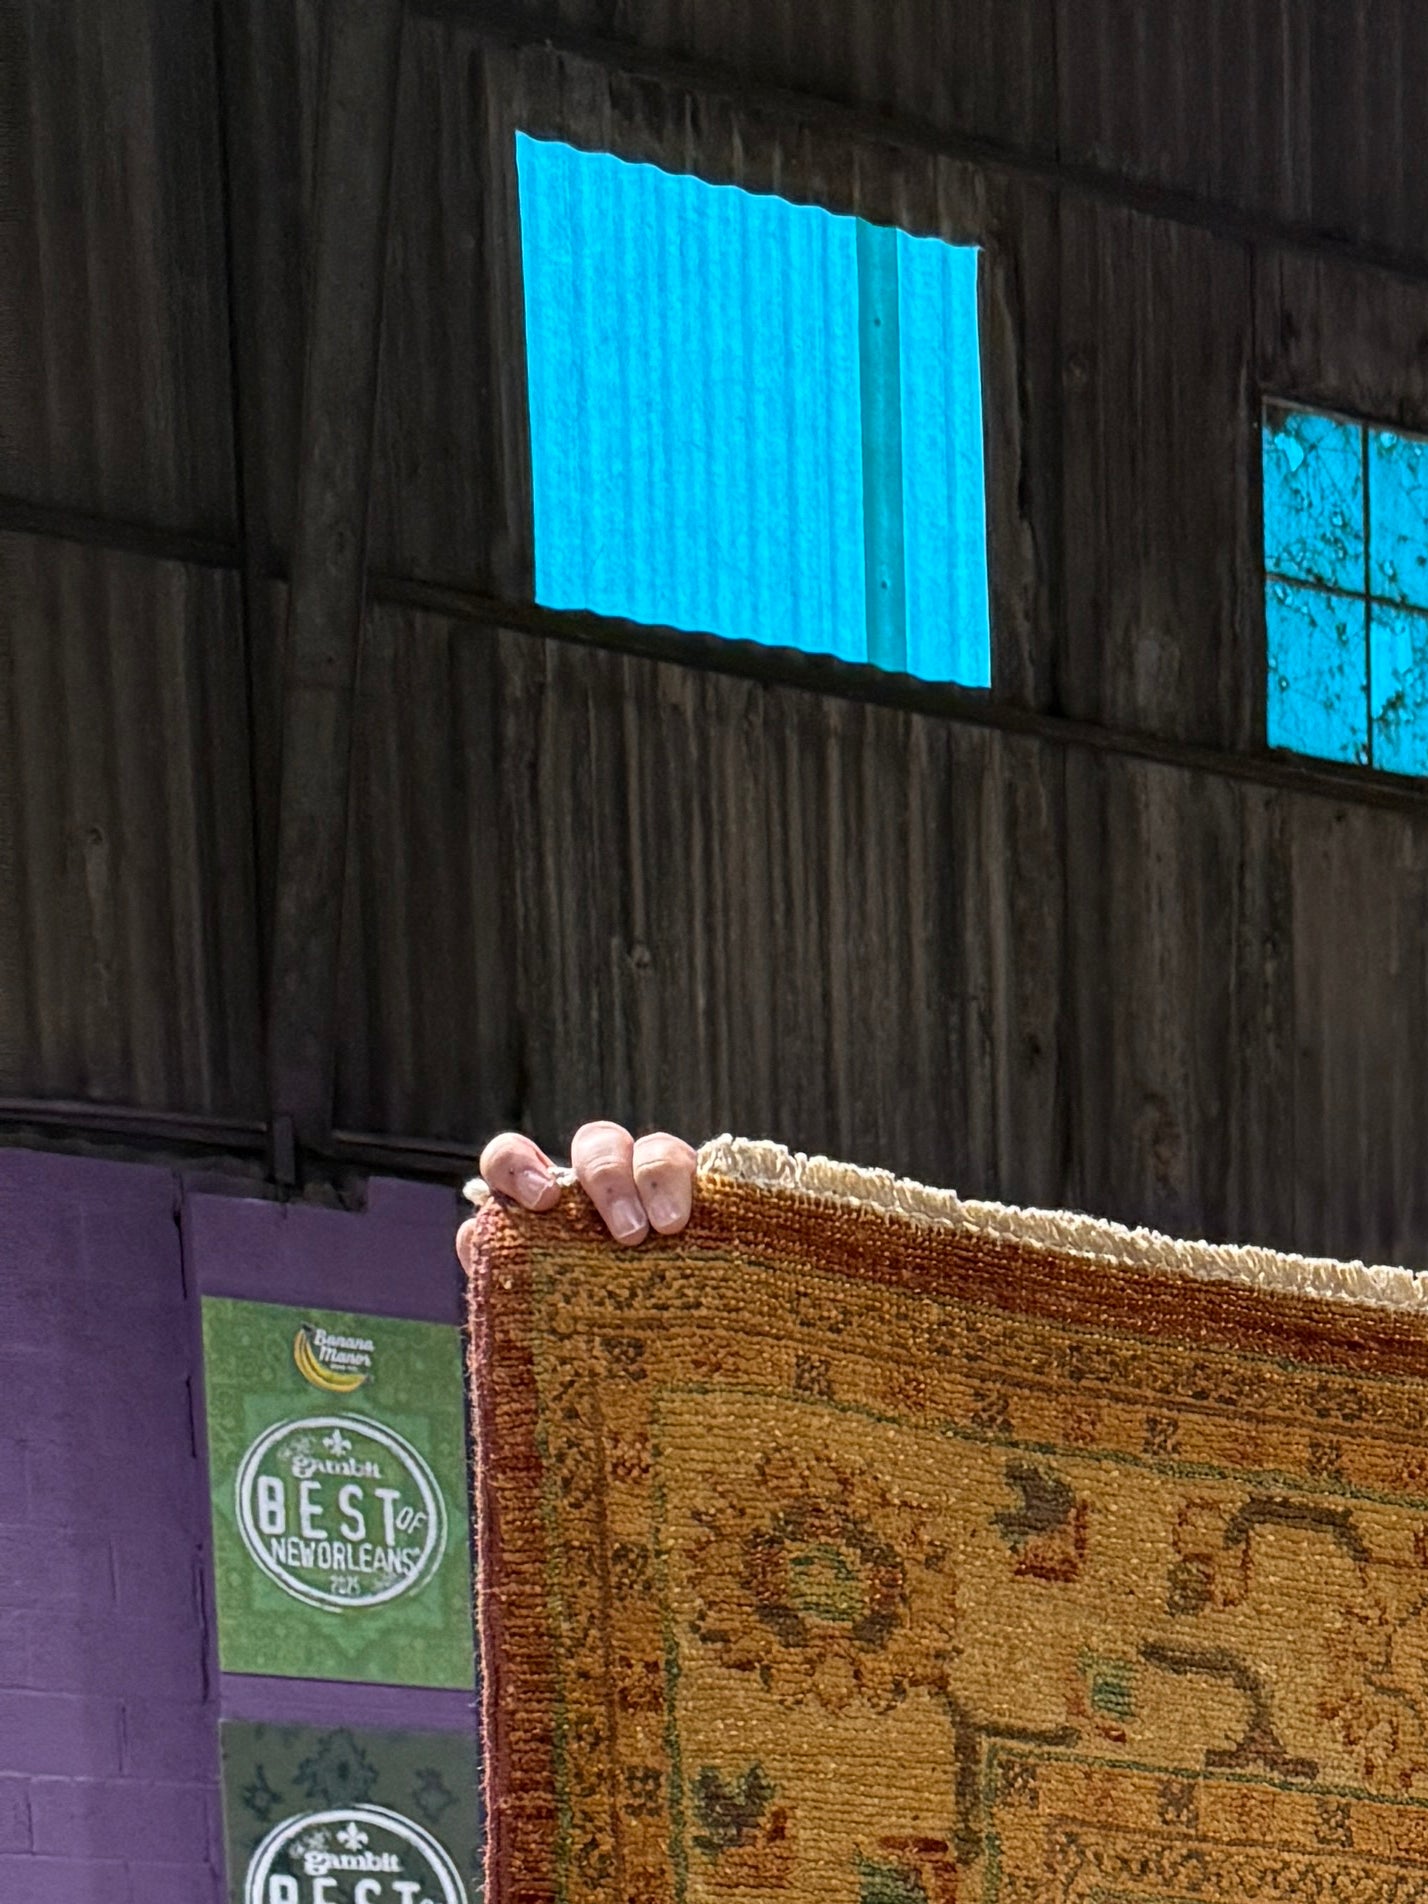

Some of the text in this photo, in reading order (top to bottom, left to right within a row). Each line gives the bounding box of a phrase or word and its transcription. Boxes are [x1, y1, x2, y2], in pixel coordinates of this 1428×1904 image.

[257, 1475, 427, 1546] BEST OF
[304, 1851, 402, 1875] gambit
